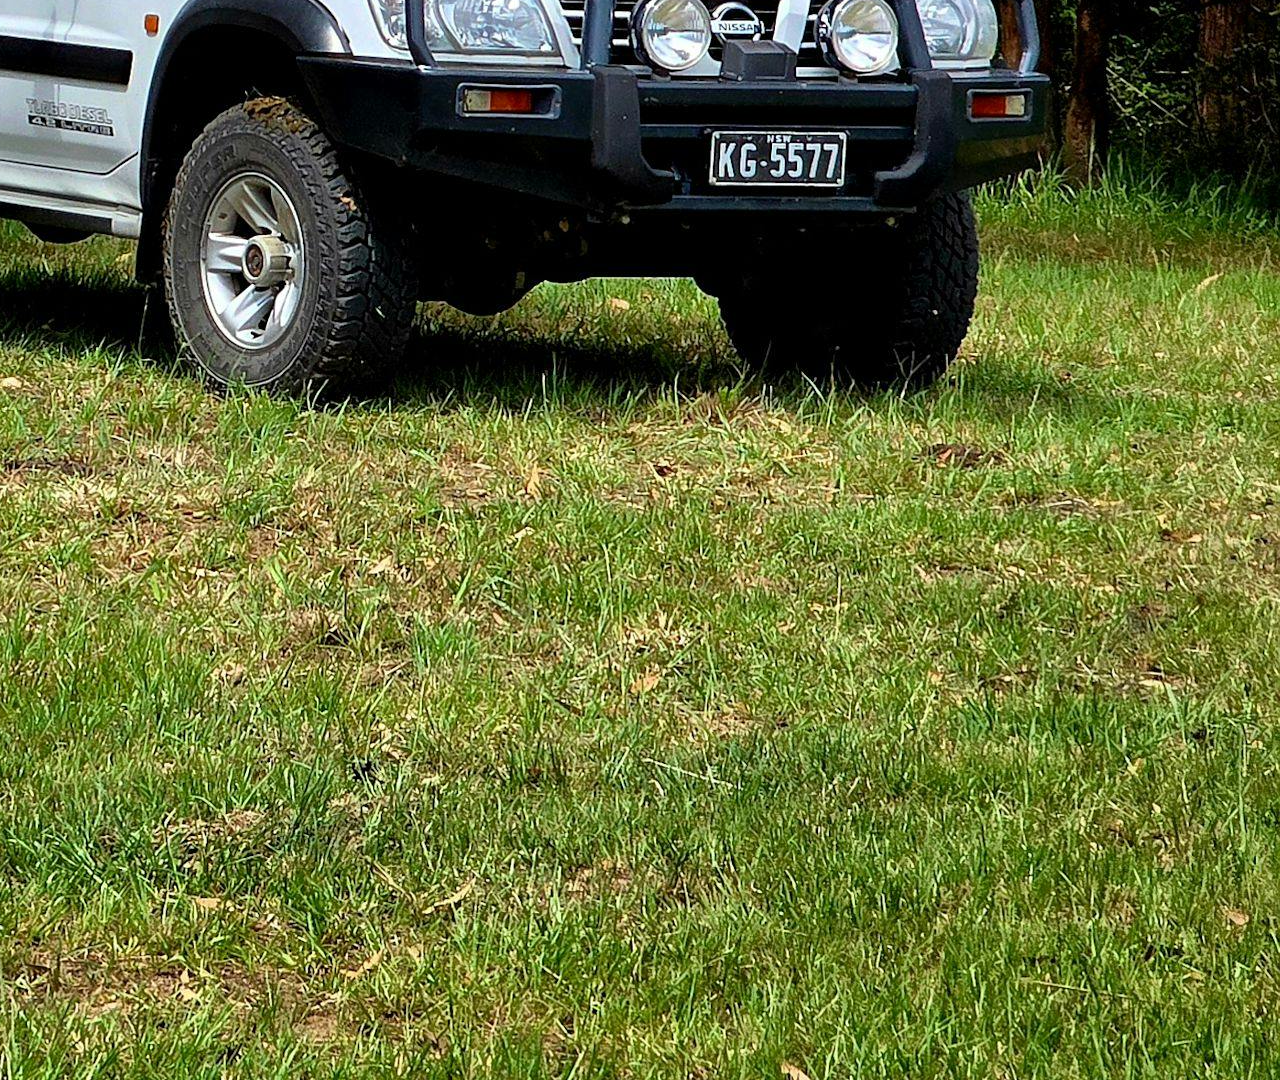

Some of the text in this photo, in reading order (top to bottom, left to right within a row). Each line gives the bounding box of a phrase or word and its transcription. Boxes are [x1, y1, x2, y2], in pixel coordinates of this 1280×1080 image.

[718, 23, 756, 31] NISSA
[26, 98, 113, 124] TURBO DIESEL
[767, 134, 792, 143] NSW
